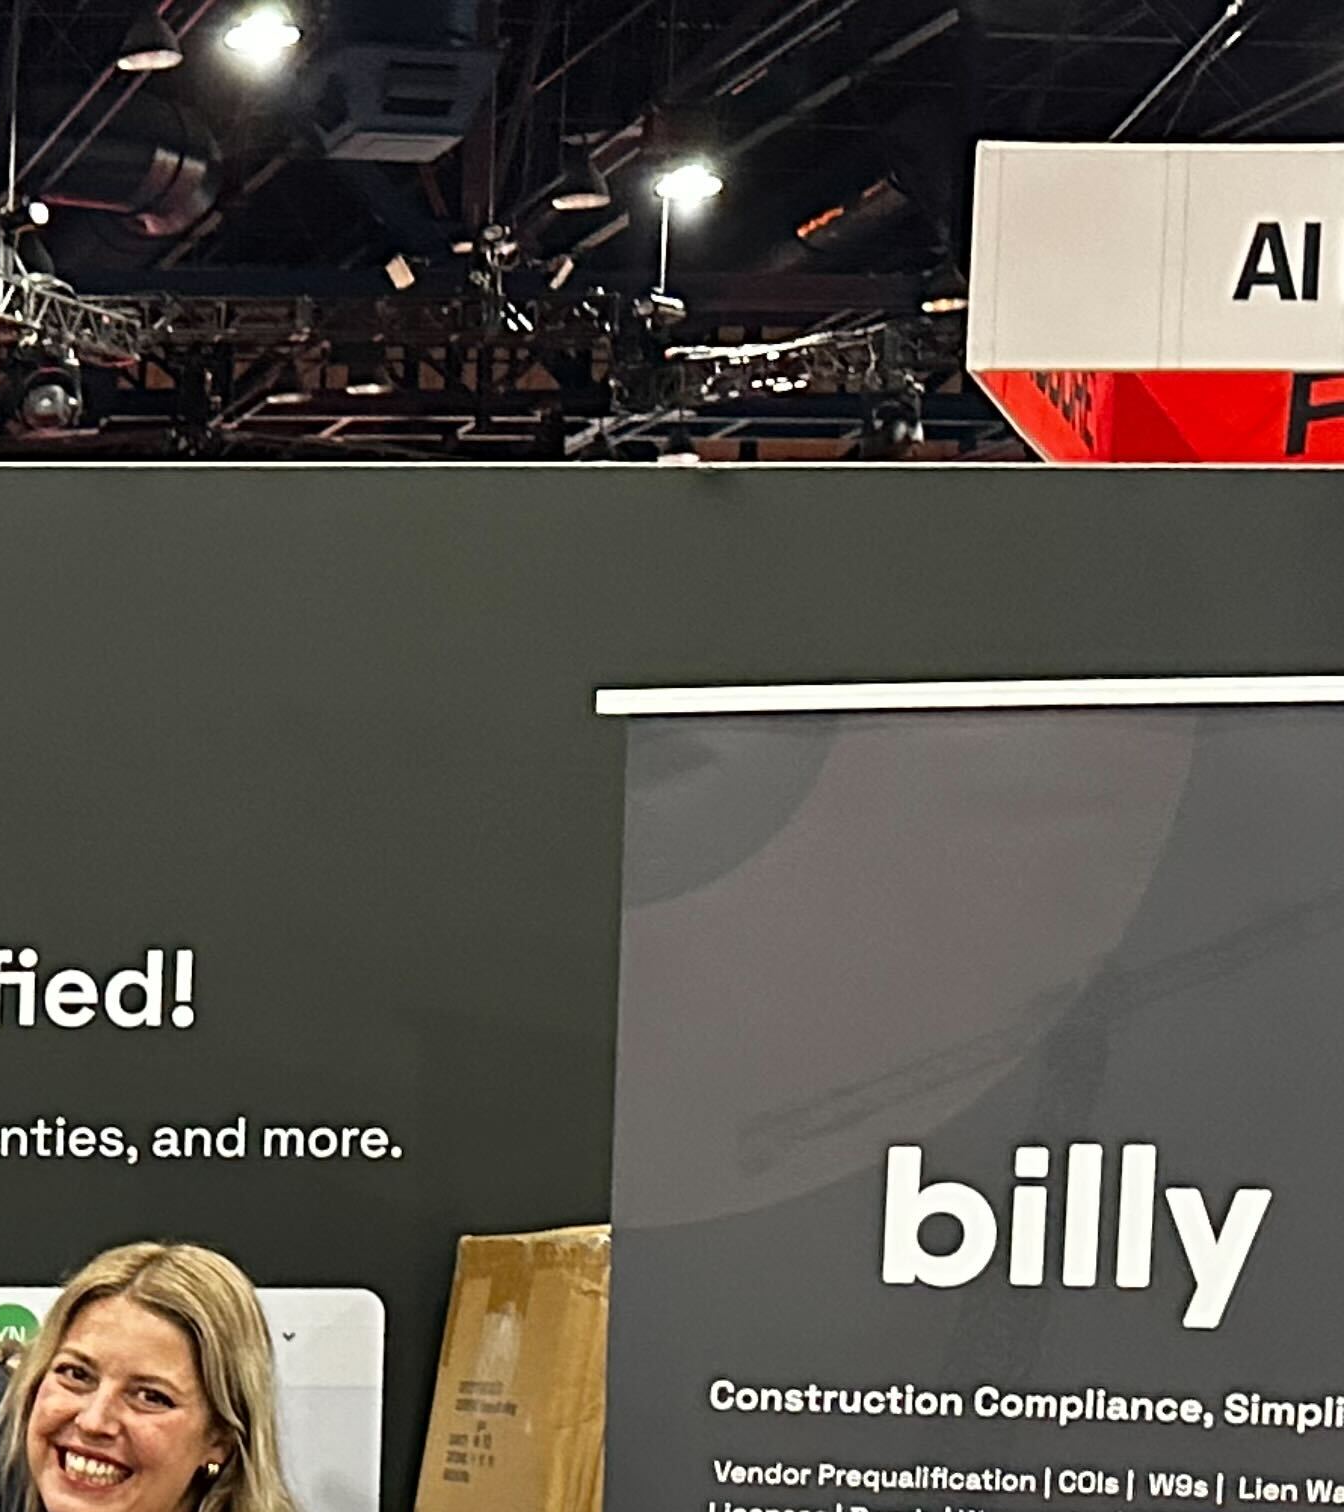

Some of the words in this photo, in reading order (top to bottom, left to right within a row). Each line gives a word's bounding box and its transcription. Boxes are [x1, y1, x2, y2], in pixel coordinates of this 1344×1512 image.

[1233, 222, 1321, 301] AI
[151, 1120, 252, 1160] and
[262, 1125, 404, 1161] more.
[883, 1144, 1272, 1328] billy
[710, 1380, 962, 1416] Construction
[975, 1386, 1213, 1428] Compliance,
[1224, 1393, 1344, 1433] Simpli
[714, 1461, 811, 1485] Vendor
[818, 1464, 1036, 1492] Prequalification
[1059, 1470, 1119, 1494] COIs
[1149, 1474, 1208, 1497] W9s
[1239, 1476, 1297, 1501] Lien
